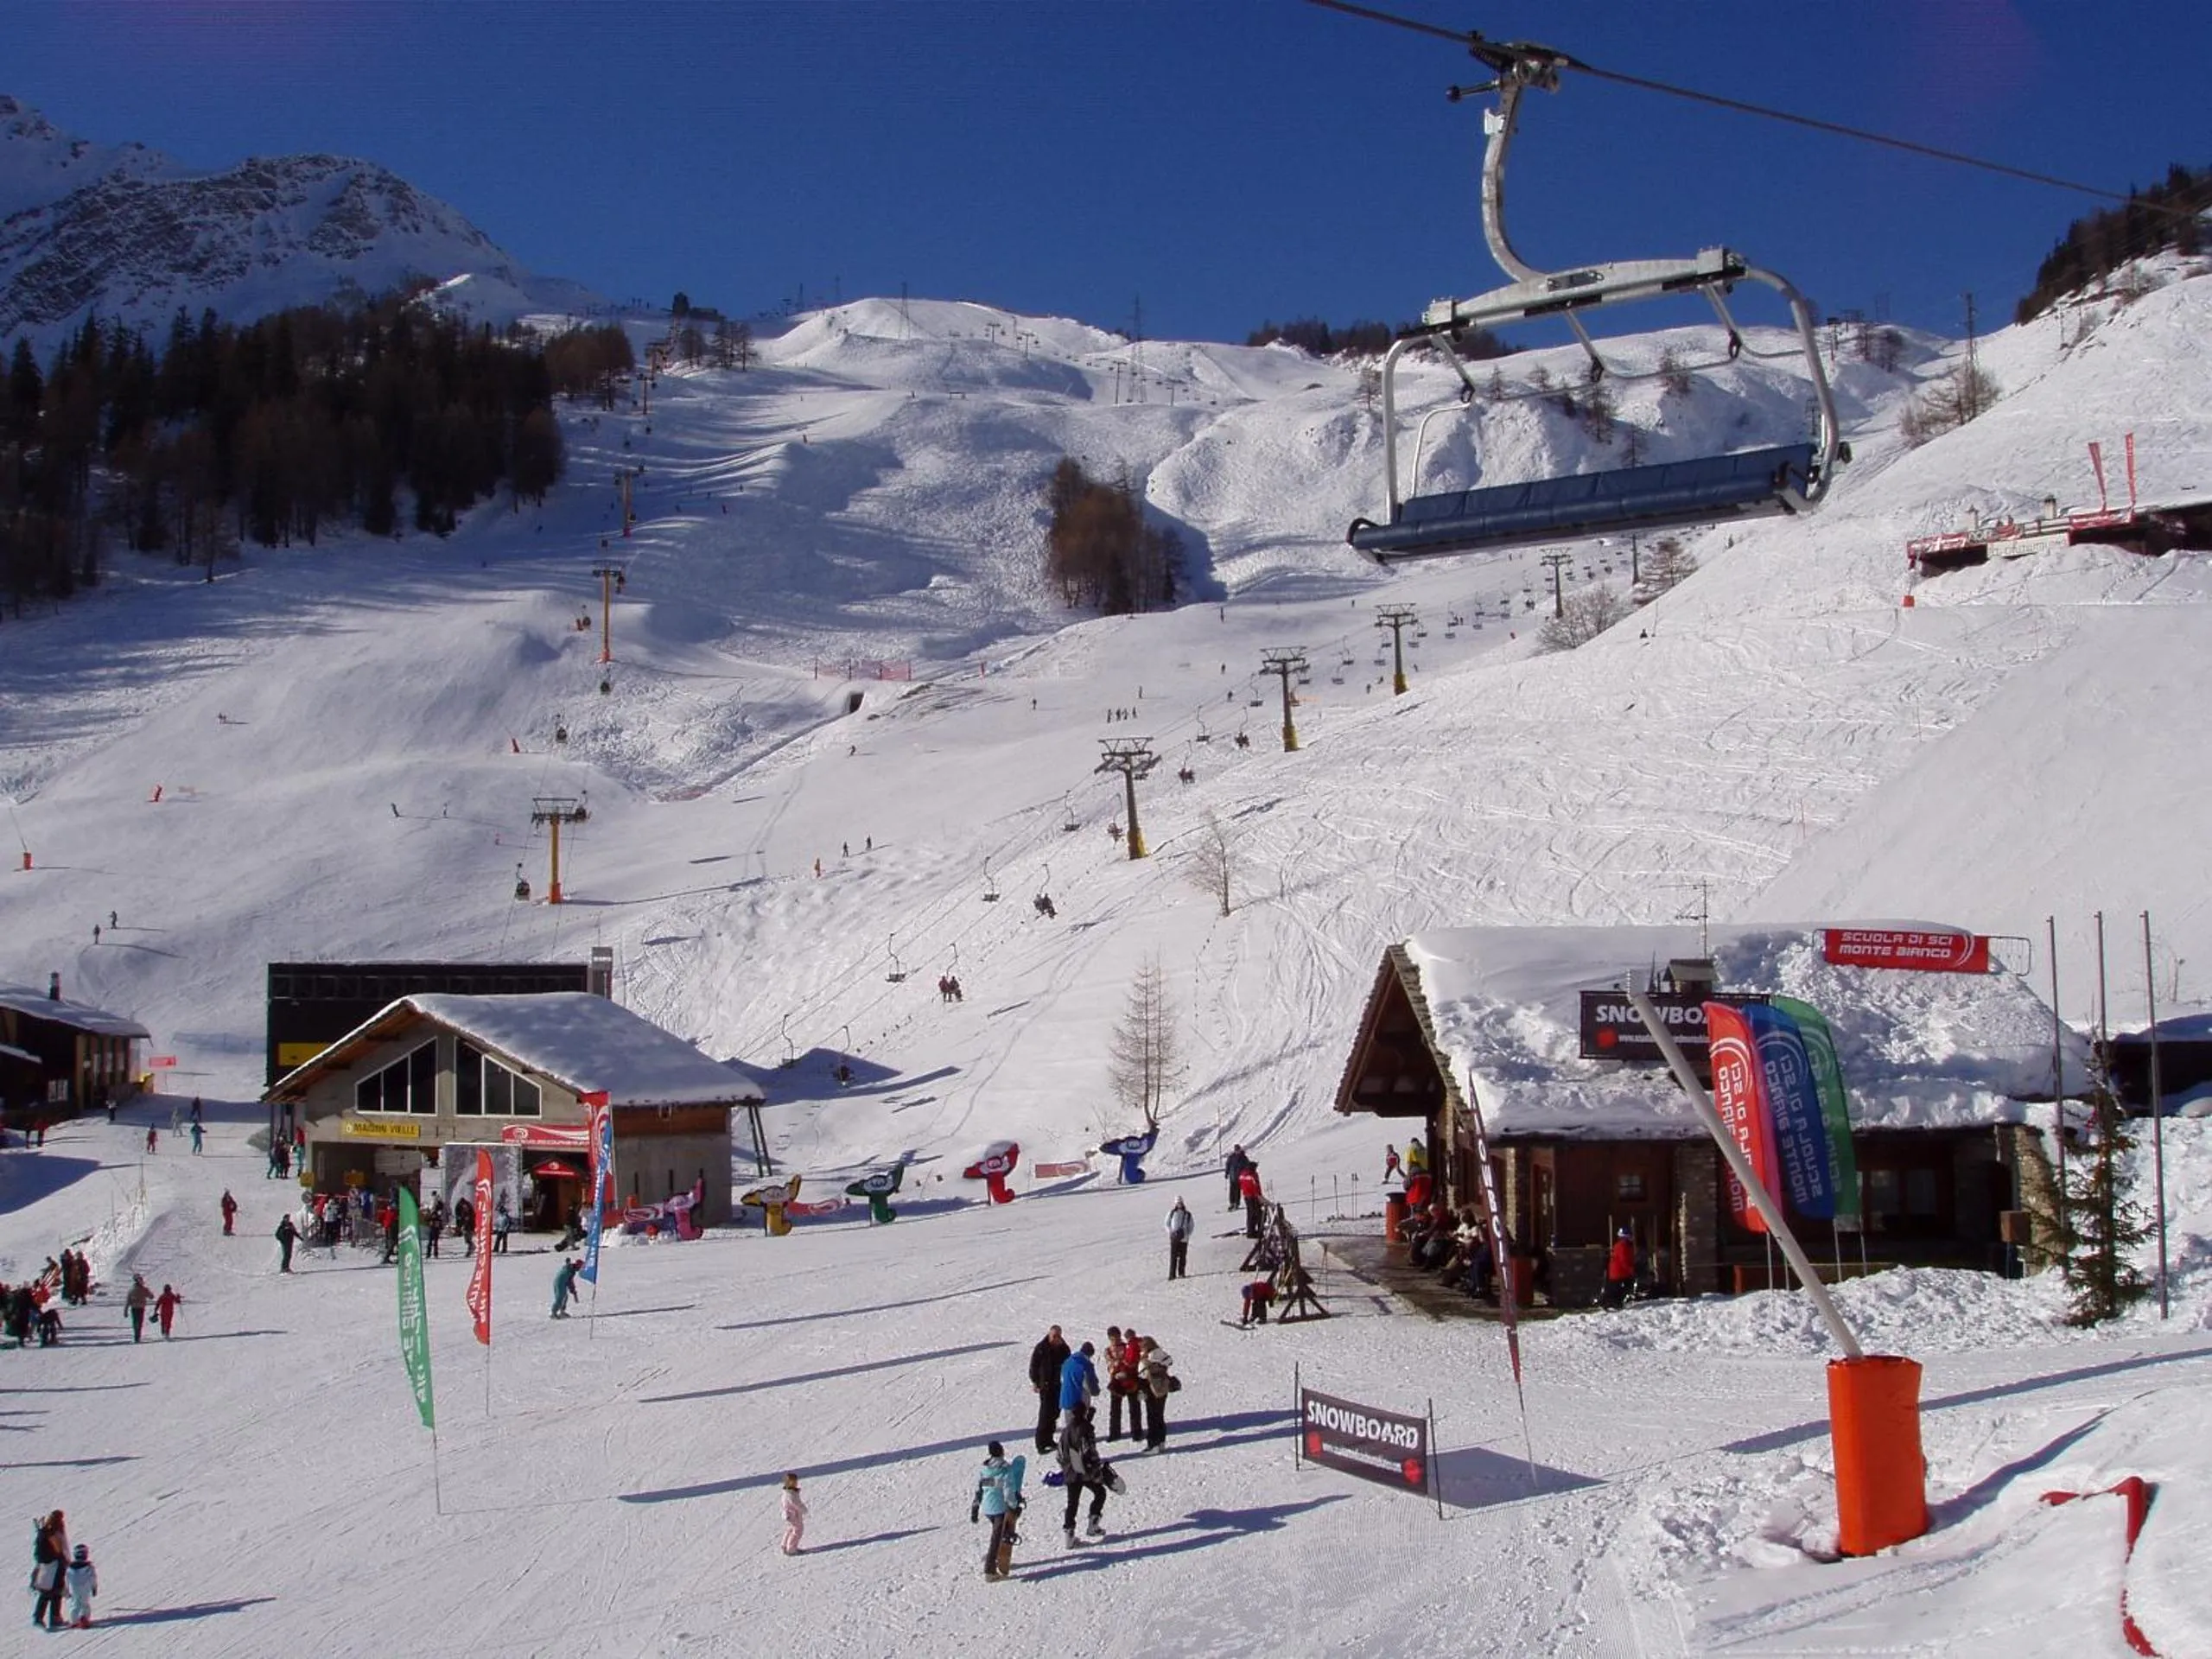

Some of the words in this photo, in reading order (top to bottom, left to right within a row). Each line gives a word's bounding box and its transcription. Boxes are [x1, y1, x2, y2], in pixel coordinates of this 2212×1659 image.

[1841, 932, 1904, 944] SCUOLA
[1908, 934, 1923, 944] DI
[1928, 935, 1953, 945] SCI
[1840, 944, 1892, 956] MONTE
[1896, 946, 1951, 958] BIANCO
[1307, 1400, 1419, 1449] SNOWBOARD
